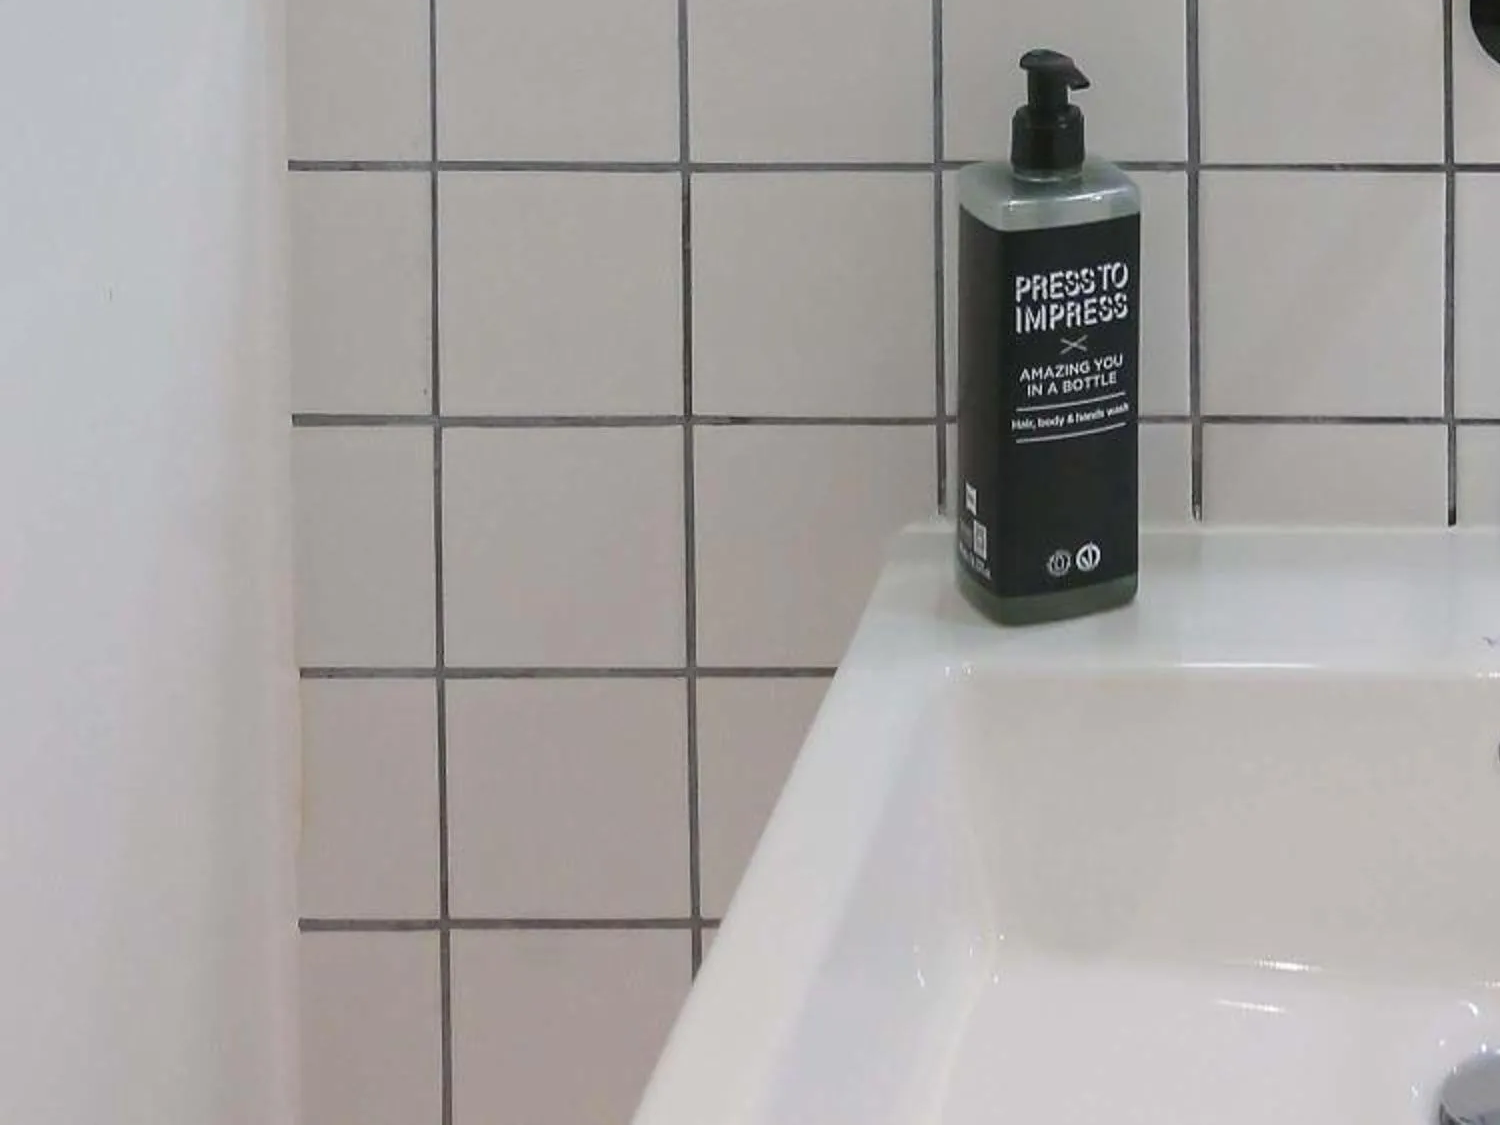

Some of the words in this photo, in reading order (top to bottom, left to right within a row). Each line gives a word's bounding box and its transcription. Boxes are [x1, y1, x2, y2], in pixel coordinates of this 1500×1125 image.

[1015, 267, 1096, 303] PRESS
[1097, 261, 1128, 291] TO
[1015, 292, 1128, 334] IMPRESS
[1019, 360, 1091, 383] AMAZING
[1094, 353, 1124, 372] YOU
[1027, 383, 1043, 397] IN
[1047, 381, 1059, 395] A
[1062, 370, 1117, 394] BOTTLE
[1037, 415, 1065, 427] body
[1075, 409, 1105, 423] hands
[1106, 402, 1129, 417] wash
